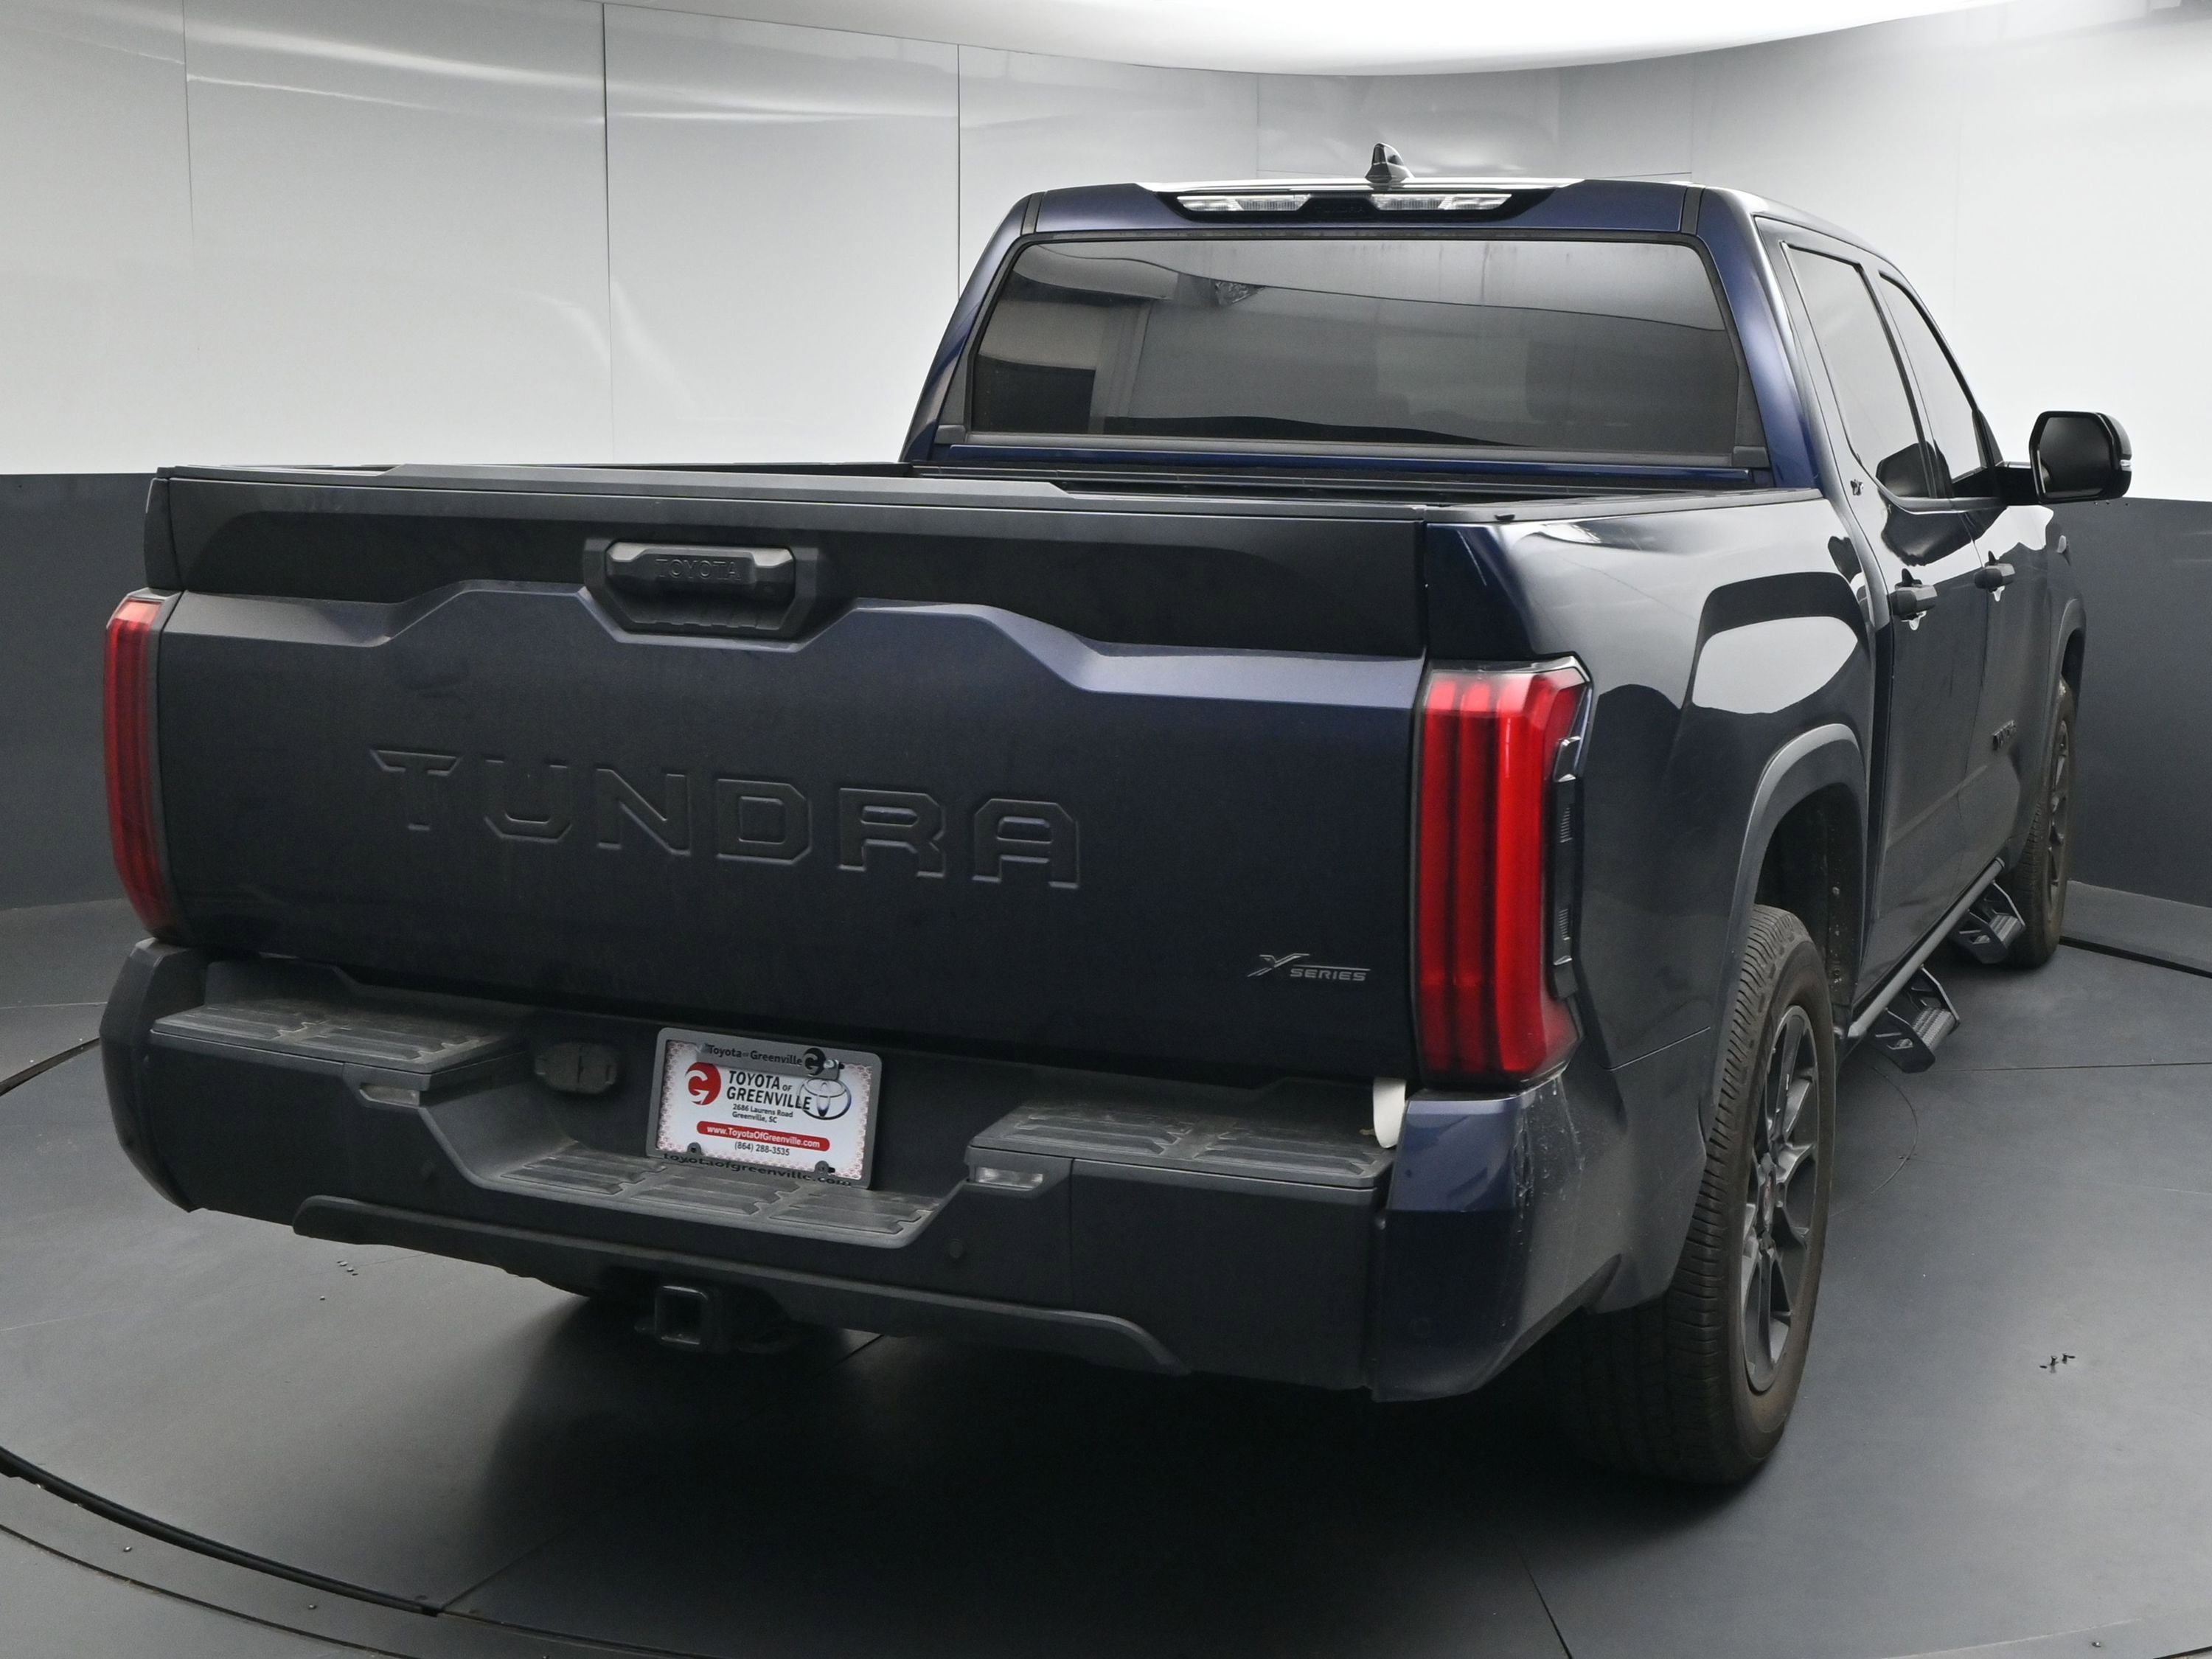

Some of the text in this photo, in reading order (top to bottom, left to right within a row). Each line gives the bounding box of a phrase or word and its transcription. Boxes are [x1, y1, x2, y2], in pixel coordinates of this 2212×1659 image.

[655, 559, 741, 580] TOYOTA
[369, 748, 1079, 888] TUNDRA
[1290, 968, 1367, 981] SERIES
[707, 1044, 742, 1058] Toyota
[750, 1050, 803, 1066] Greenville
[728, 1071, 793, 1092] TOYOTA OF
[726, 1086, 813, 1110] GREENVILLE
[732, 1111, 778, 1124] Greenville, SC
[750, 1105, 776, 1116] Laurens
[776, 1108, 793, 1118] Road
[706, 1125, 820, 1148] www.ToyotaOfGreenville.com
[734, 1142, 790, 1156] (864) 288-3535
[664, 1153, 852, 1186] toyotaofgreenville.com
